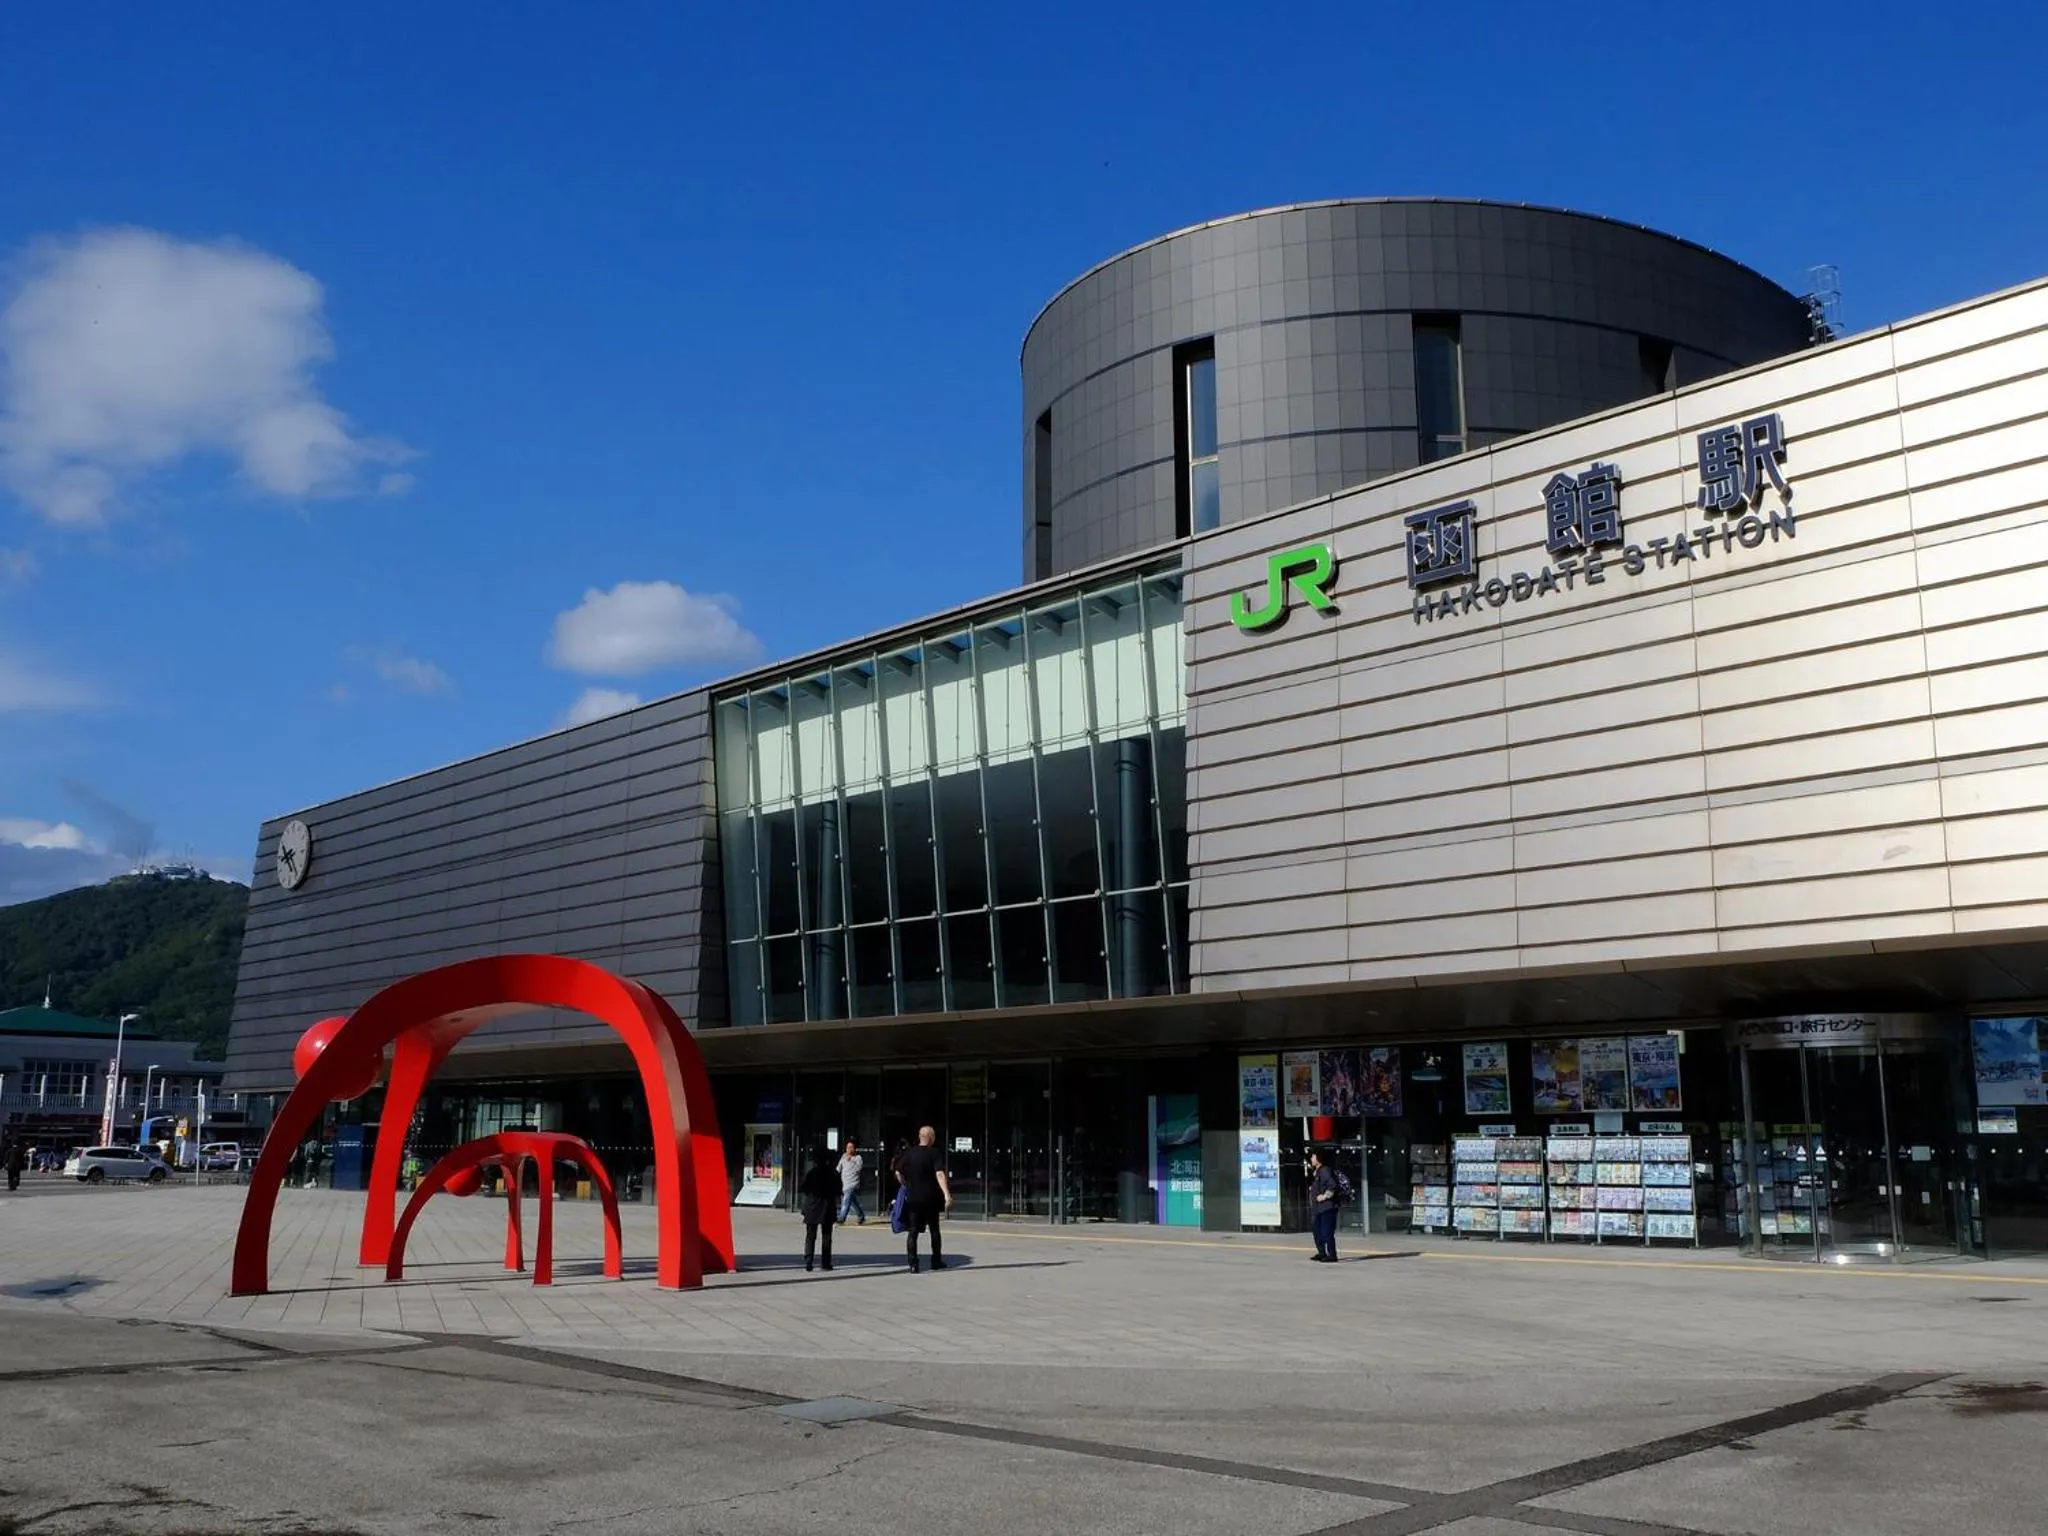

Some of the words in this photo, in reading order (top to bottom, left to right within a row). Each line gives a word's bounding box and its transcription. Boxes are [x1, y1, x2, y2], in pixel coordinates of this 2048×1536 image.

[1405, 412, 1793, 589] 函館駅
[1230, 543, 1338, 631] JR
[1414, 556, 1605, 624] HAKODATE
[1624, 508, 1796, 575] STATION
